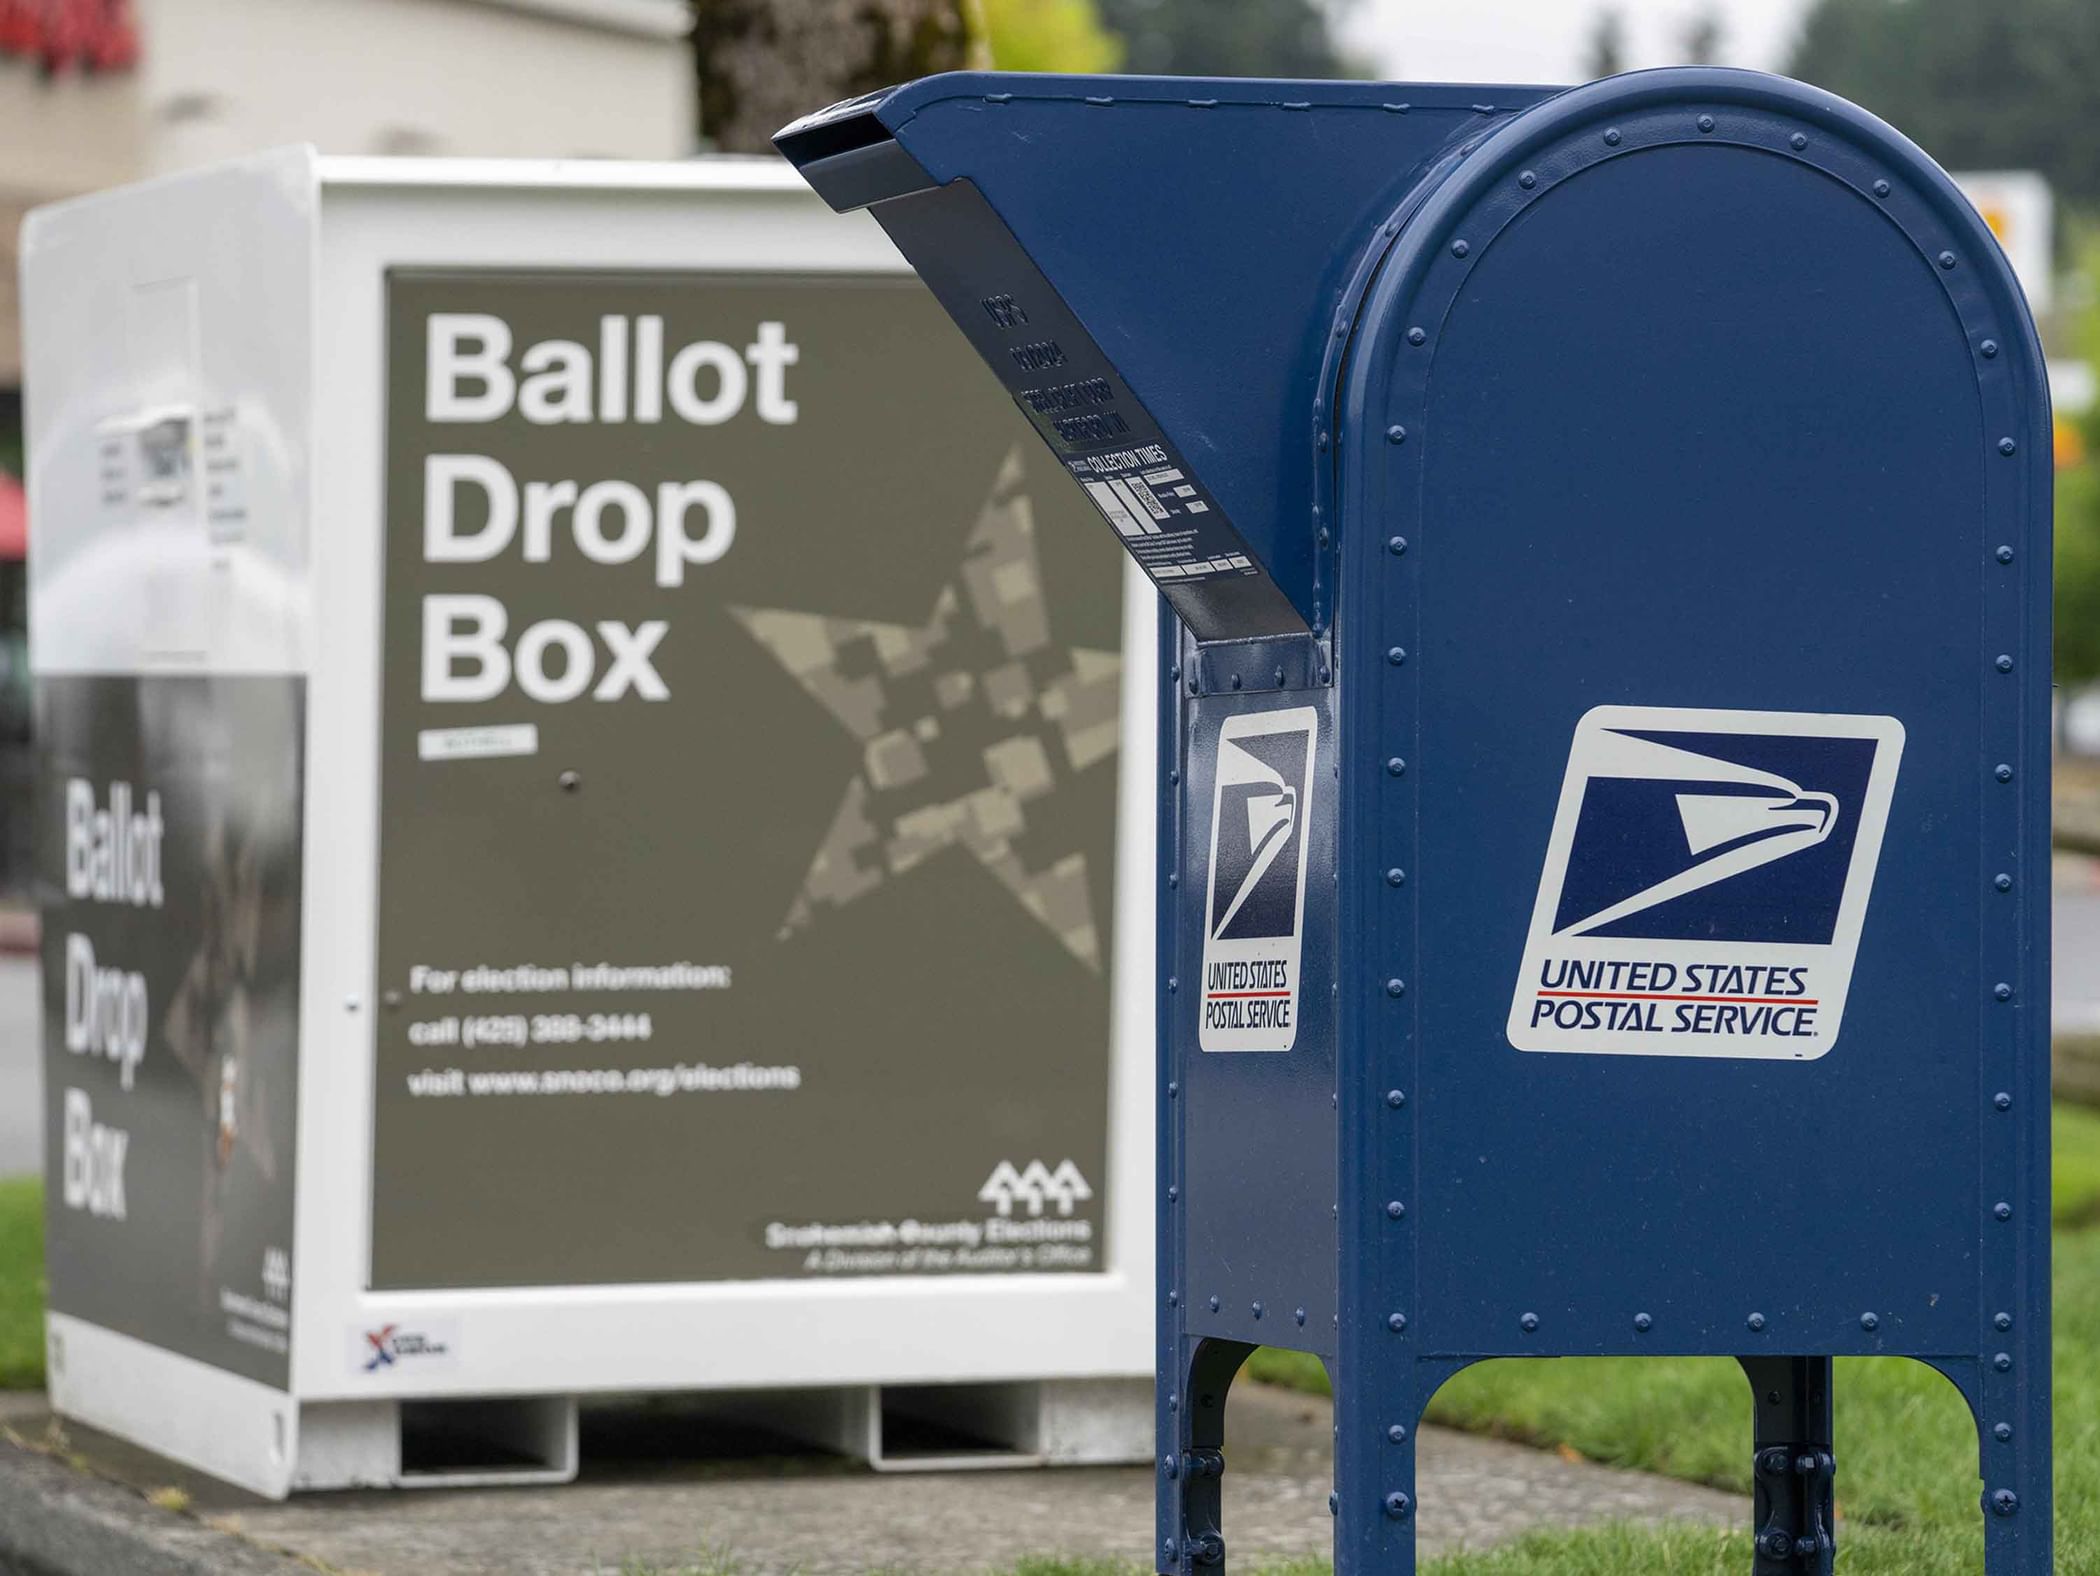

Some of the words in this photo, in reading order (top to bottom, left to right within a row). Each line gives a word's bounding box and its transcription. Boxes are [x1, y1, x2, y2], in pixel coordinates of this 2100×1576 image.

[426, 313, 799, 424] Ballot
[1087, 449, 1141, 473] COLLECTION
[1135, 444, 1168, 465] TIMES
[424, 454, 736, 587] Drop
[421, 594, 672, 703] Box
[66, 778, 163, 906] Ballot
[410, 965, 458, 993] For
[461, 964, 569, 993] election
[1208, 962, 1248, 990] UNITED
[1249, 960, 1287, 989] STATES
[1541, 959, 1677, 992] UNITED
[1682, 964, 1808, 995] STATES
[65, 932, 148, 1090] Drop
[1206, 1001, 1244, 1029] POSTAL
[1246, 1000, 1290, 1028] SERVICE
[1530, 999, 1664, 1032] POSTAL
[1671, 1004, 1818, 1036] SERVICE
[409, 1017, 459, 1044] call
[408, 1068, 464, 1096] visit
[64, 1087, 129, 1220] Box
